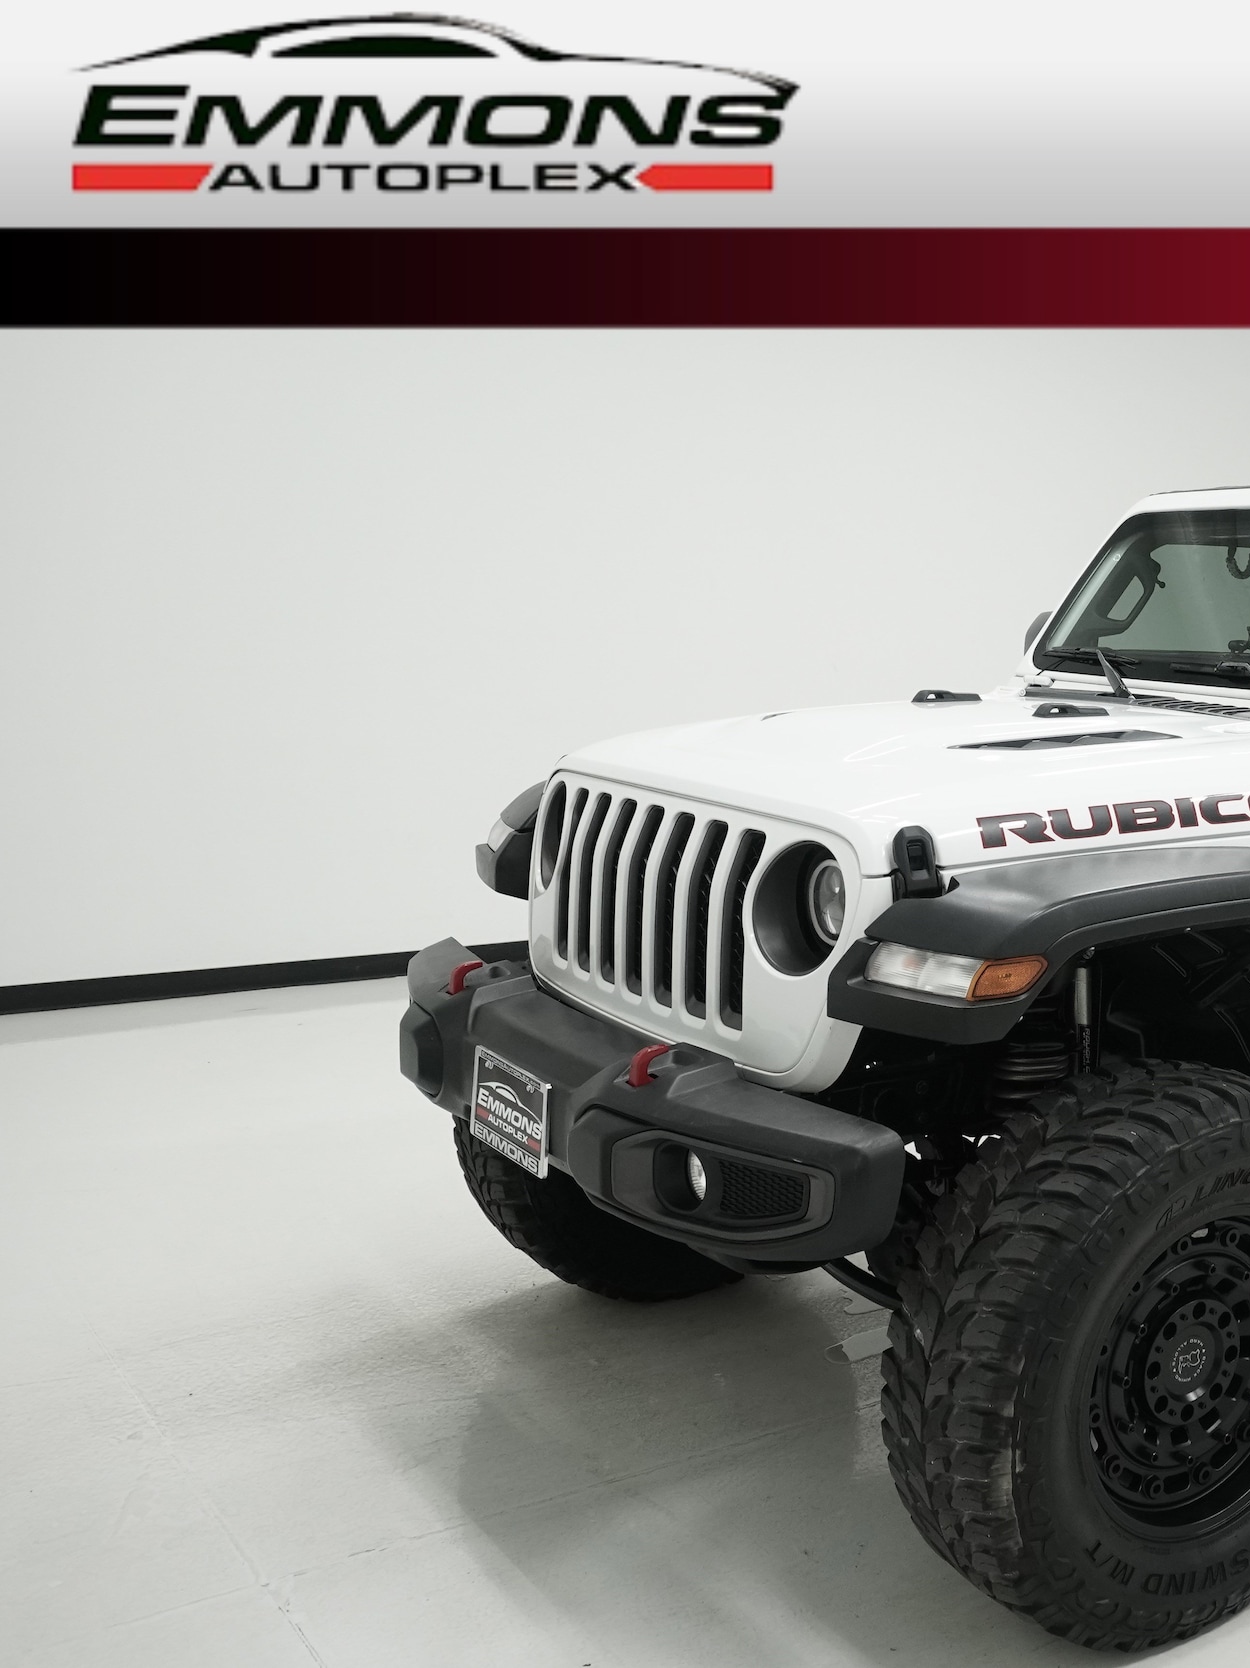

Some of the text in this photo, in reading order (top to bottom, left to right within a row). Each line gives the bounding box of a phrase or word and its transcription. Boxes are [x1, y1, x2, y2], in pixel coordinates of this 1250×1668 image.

[477, 1087, 543, 1140] EMMONS
[487, 1113, 529, 1145] AUTOPLEX
[474, 1123, 539, 1174] EMMONS
[1085, 1538, 1136, 1586] M/T
